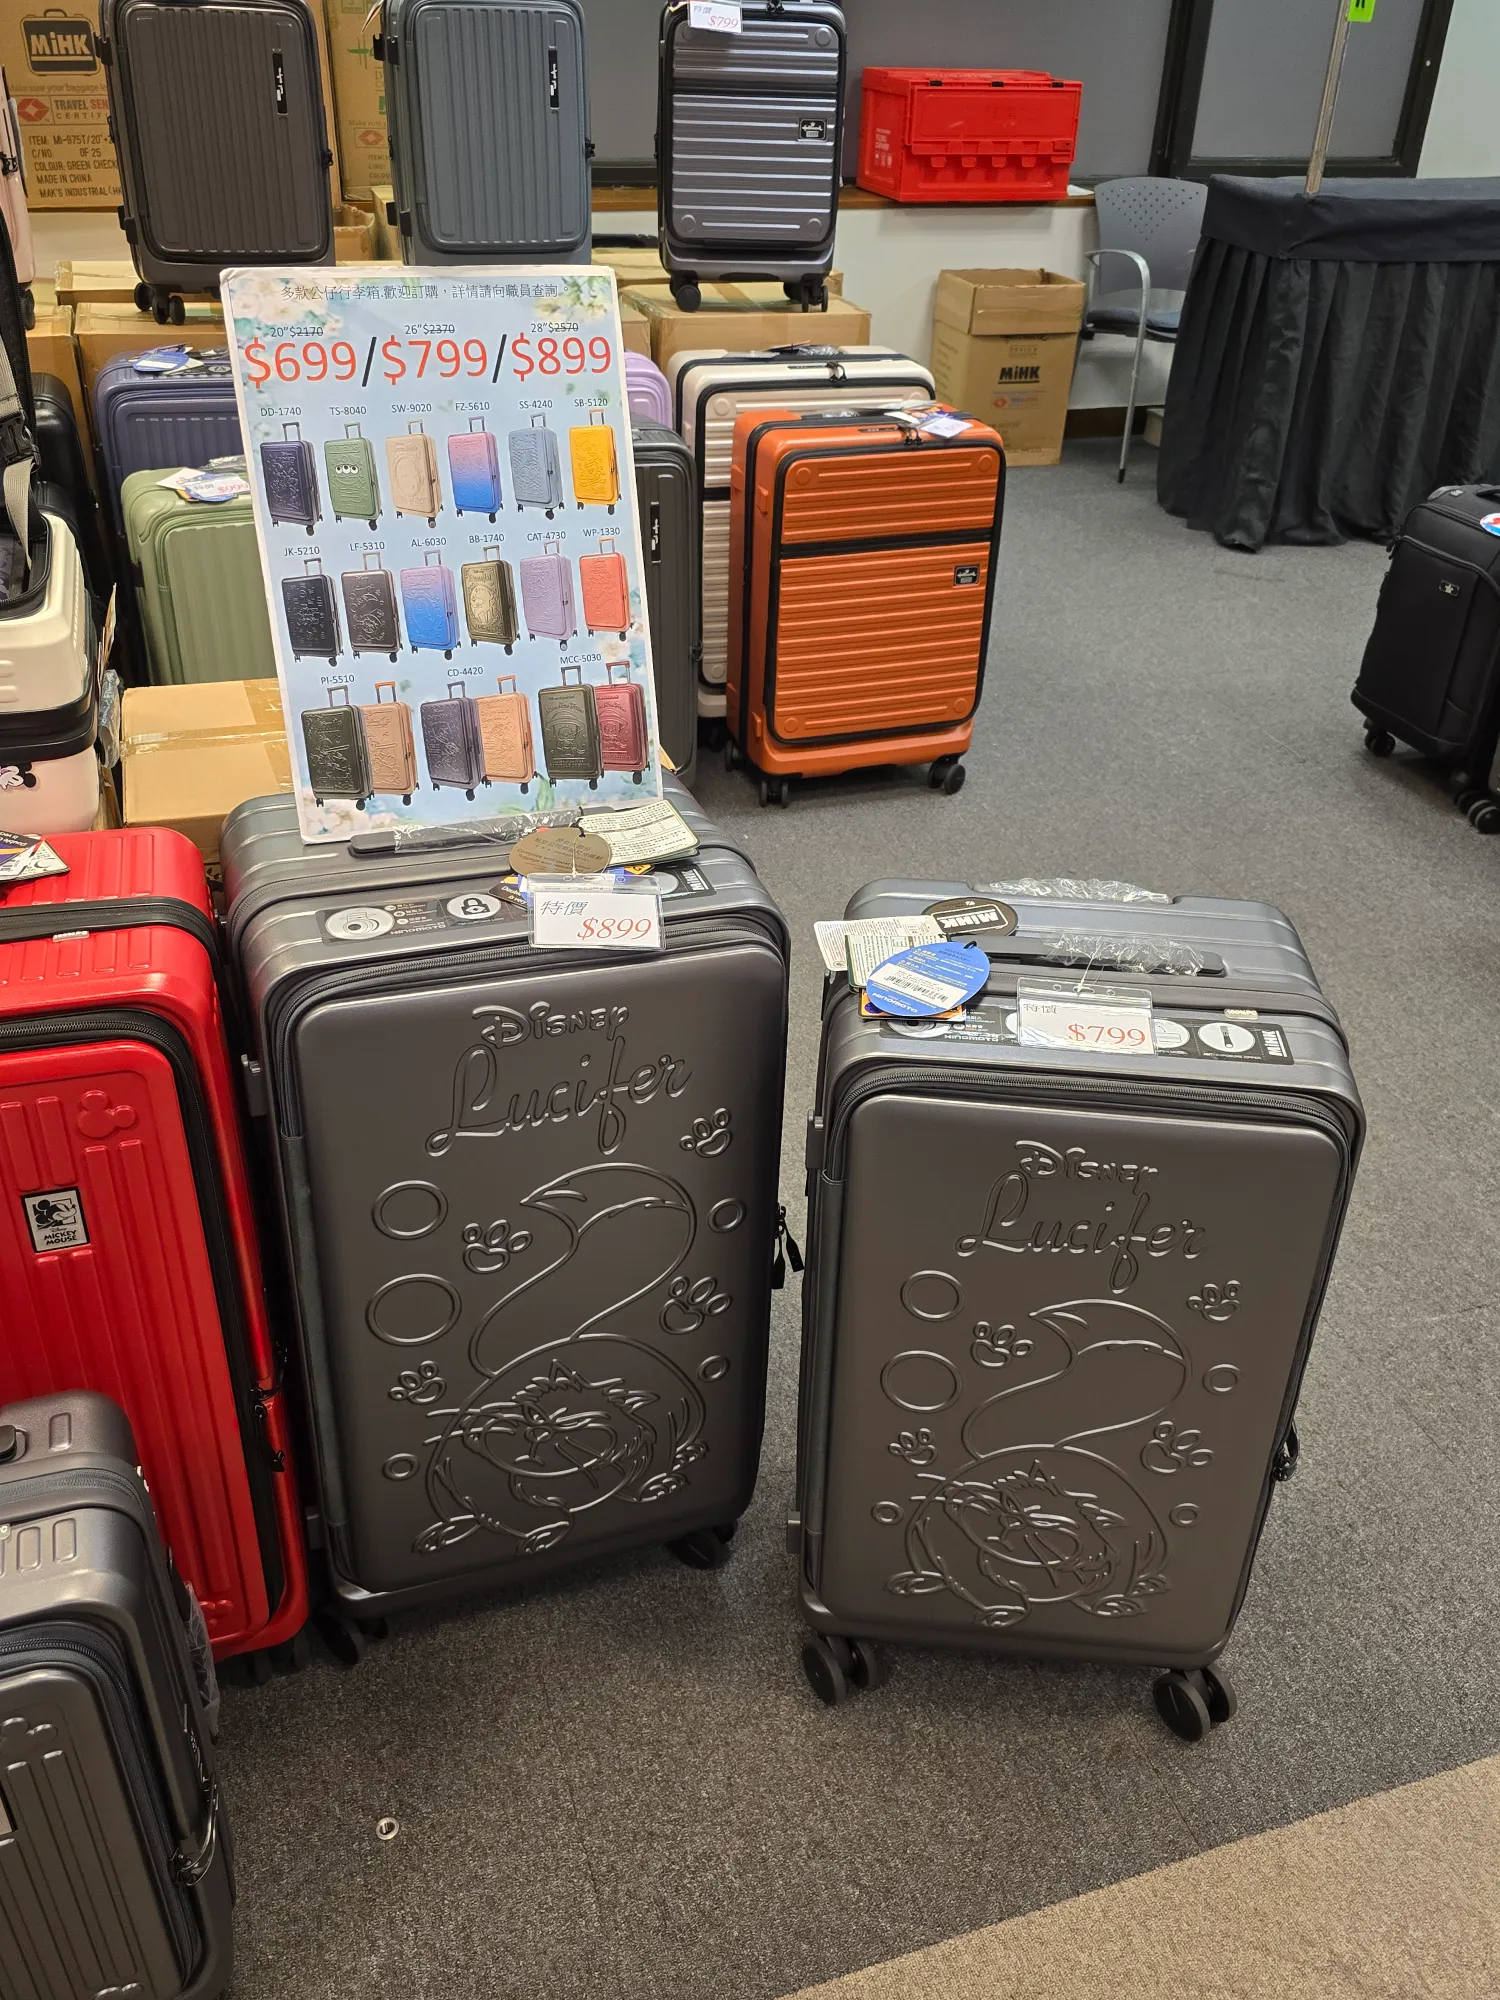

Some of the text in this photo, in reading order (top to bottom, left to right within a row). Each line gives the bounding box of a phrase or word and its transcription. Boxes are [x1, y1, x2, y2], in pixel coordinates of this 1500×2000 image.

[708, 15, 739, 29] $799
[30, 31, 91, 55] MiHK
[47, 85, 65, 93] your
[65, 83, 100, 93] baggage
[54, 99, 89, 111] TRAVEL
[91, 147, 102, 158] 25
[67, 161, 91, 171] GREEN
[36, 173, 93, 184] MADE IN CHINA
[39, 187, 63, 198] MAK'S
[1000, 365, 1041, 380] MiHK
[391, 402, 432, 414] SW-9020
[455, 401, 490, 412] FZ-5610
[518, 399, 553, 410] SS-4240
[574, 397, 608, 408] SB-5120
[260, 406, 302, 417] DD-1740
[328, 406, 367, 417] TS-8040
[527, 531, 567, 542] CAT-4730
[582, 526, 621, 537] WP-1330
[411, 536, 447, 548] AL-6030
[469, 533, 505, 544] BB-1740
[284, 545, 320, 557] JK-5210
[350, 541, 386, 552] LF-5310
[559, 652, 602, 665] MCC-5030
[447, 666, 484, 677] CD-4420
[320, 673, 355, 685] PI-5510
[540, 901, 589, 916] 特價
[576, 916, 652, 940] $899
[1023, 1003, 1060, 1014] 特價
[1067, 1023, 1146, 1046] $799
[424, 1036, 693, 1157] Lucifer
[44, 1229, 77, 1241] MICKEY
[46, 1234, 78, 1246] MOUSE
[955, 1191, 1206, 1295] Lucifer
